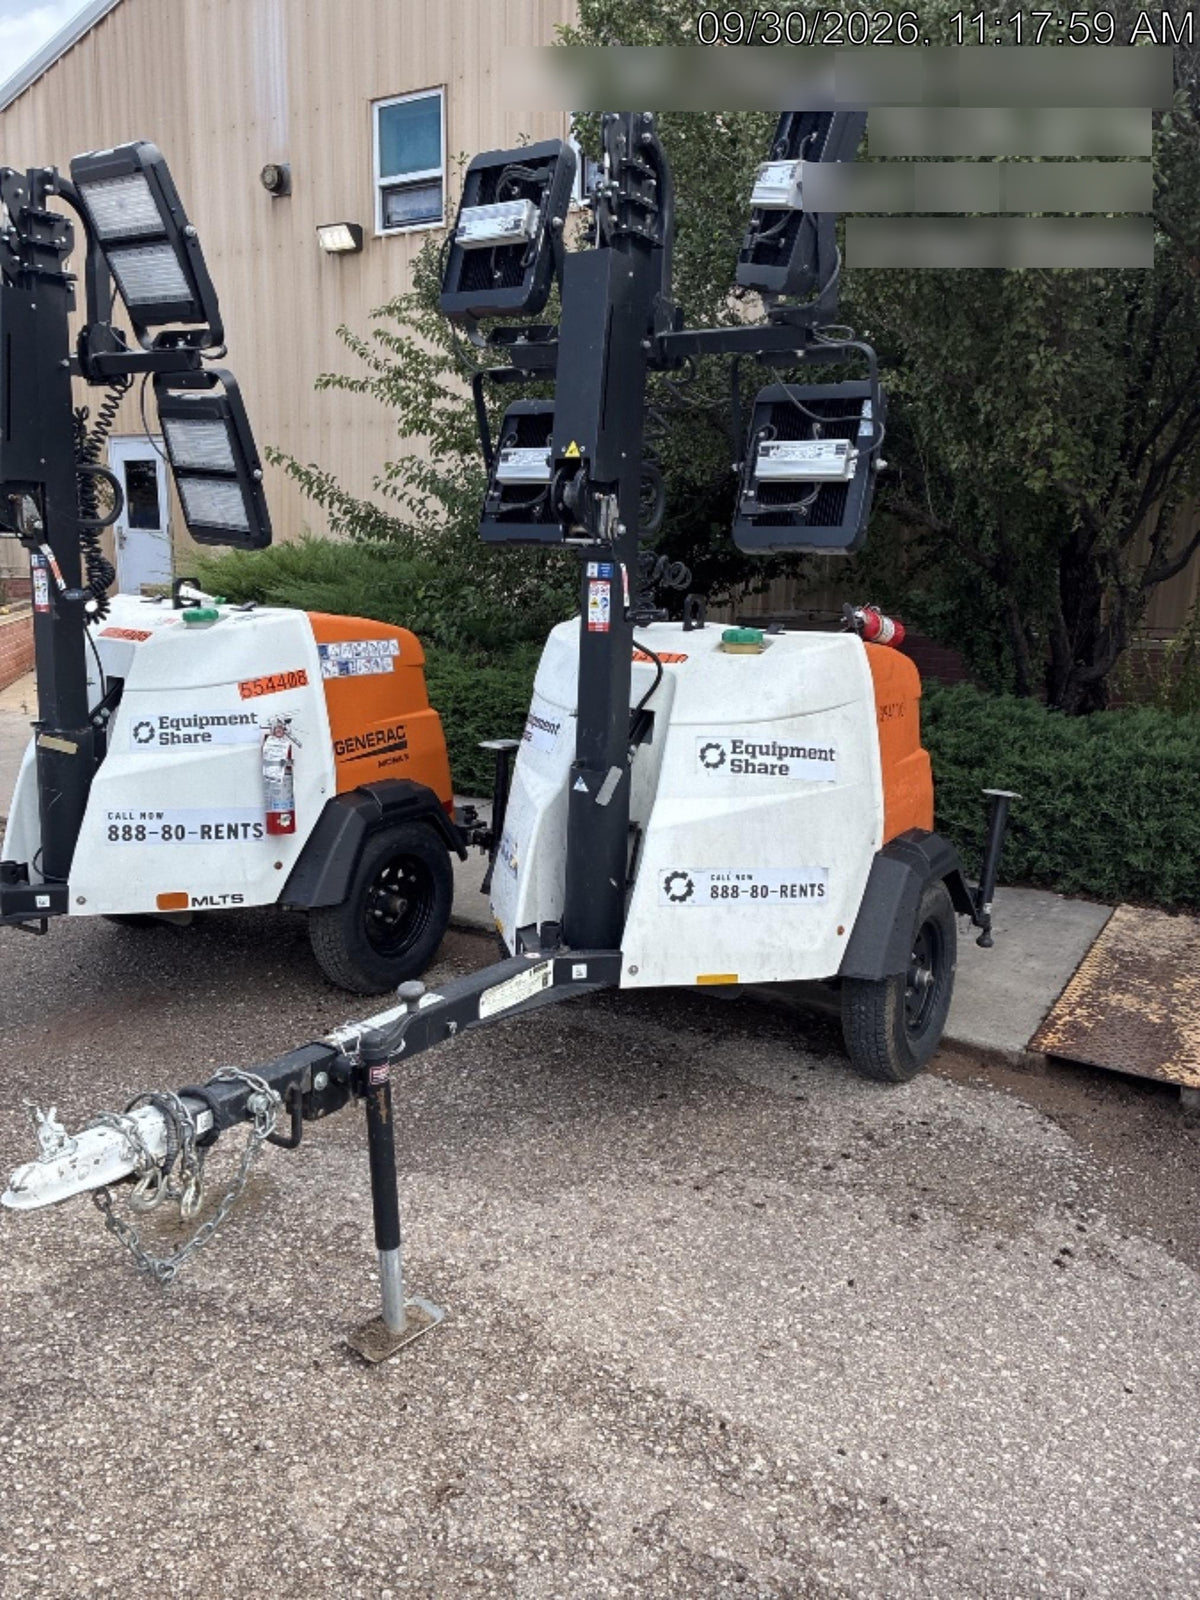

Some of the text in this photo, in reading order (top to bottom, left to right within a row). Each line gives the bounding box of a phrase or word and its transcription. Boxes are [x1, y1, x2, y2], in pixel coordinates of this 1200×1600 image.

[158, 712, 258, 732] Equipment
[158, 731, 212, 746] Share
[334, 724, 406, 756] GENERAC
[730, 739, 836, 762] Equipment
[730, 758, 790, 776] Share
[107, 811, 165, 821] CALL NOW
[107, 823, 264, 842] 888-80-RENTS
[191, 893, 245, 907] MLTS
[710, 883, 825, 899] 888-80-RENTS
